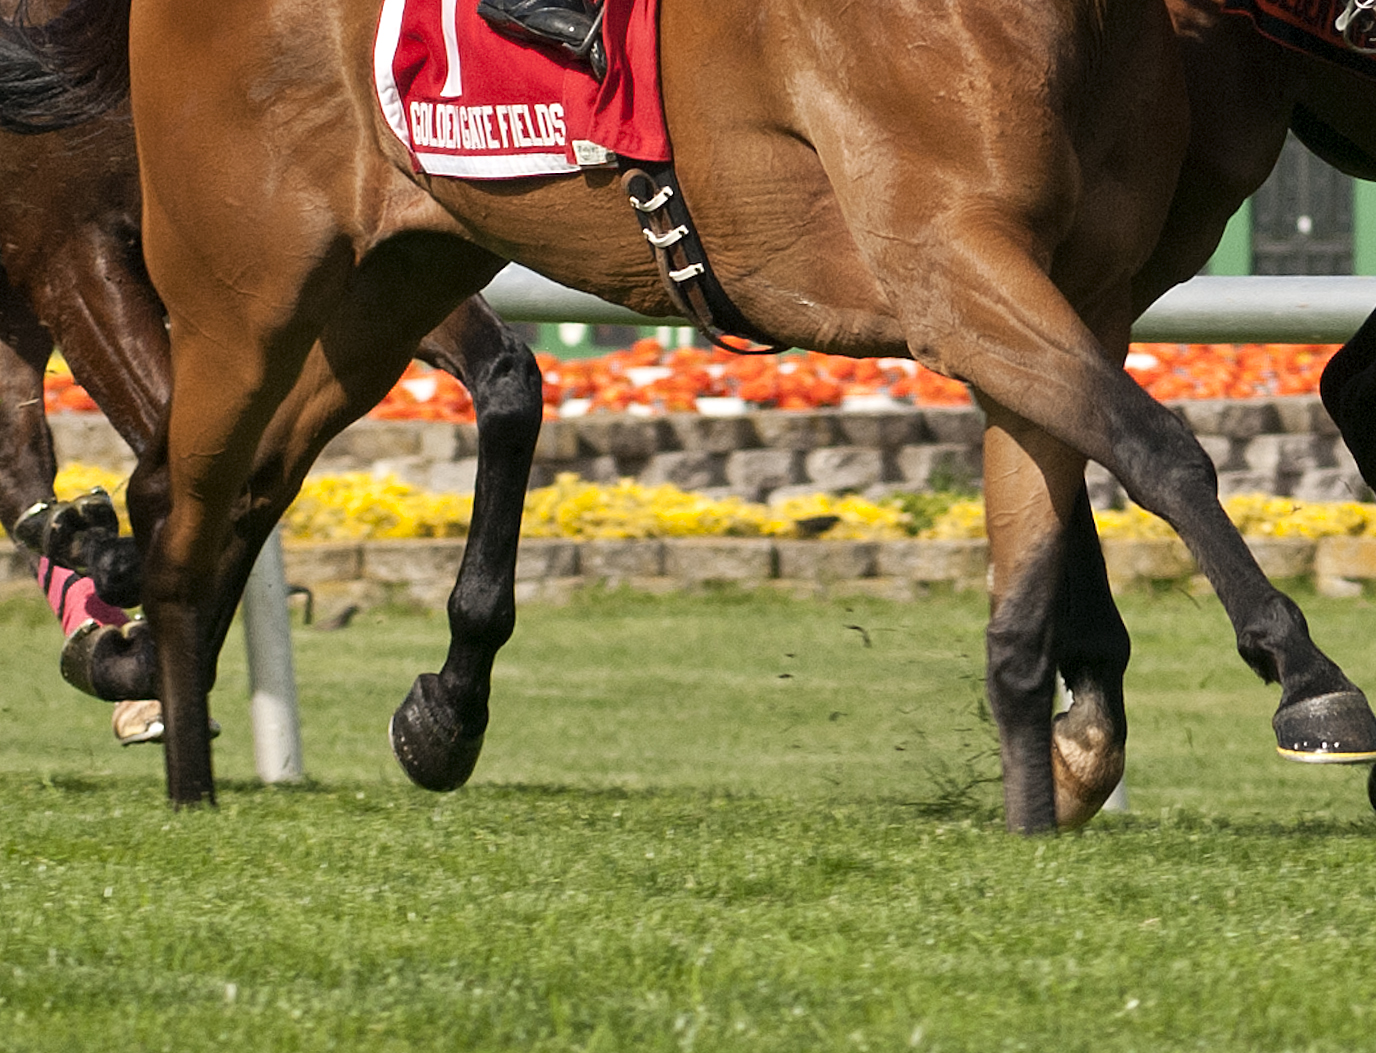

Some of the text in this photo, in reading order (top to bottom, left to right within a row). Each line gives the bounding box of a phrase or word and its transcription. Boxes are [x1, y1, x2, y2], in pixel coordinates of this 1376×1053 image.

[410, 101, 566, 149] GOLDEN GATE FIELDS
